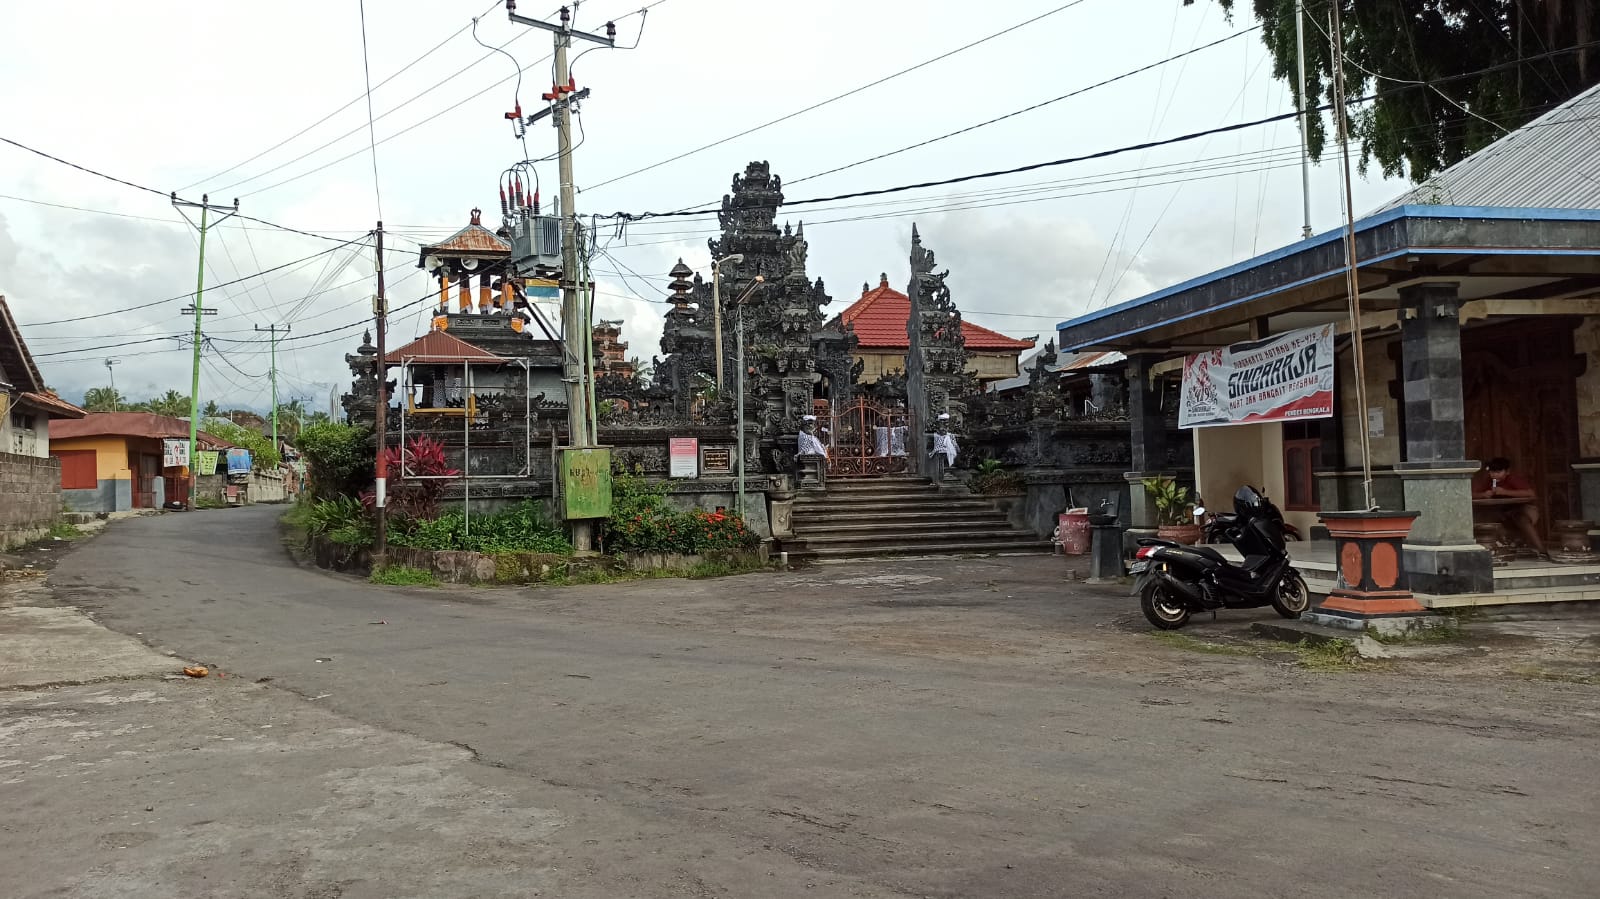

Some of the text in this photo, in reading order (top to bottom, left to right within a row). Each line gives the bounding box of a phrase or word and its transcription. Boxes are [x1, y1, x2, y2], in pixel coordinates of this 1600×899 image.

[1264, 343, 1289, 359] KOTAKU
[1228, 343, 1317, 399] SINGARAJA
[1259, 385, 1286, 401] BANGKIT
